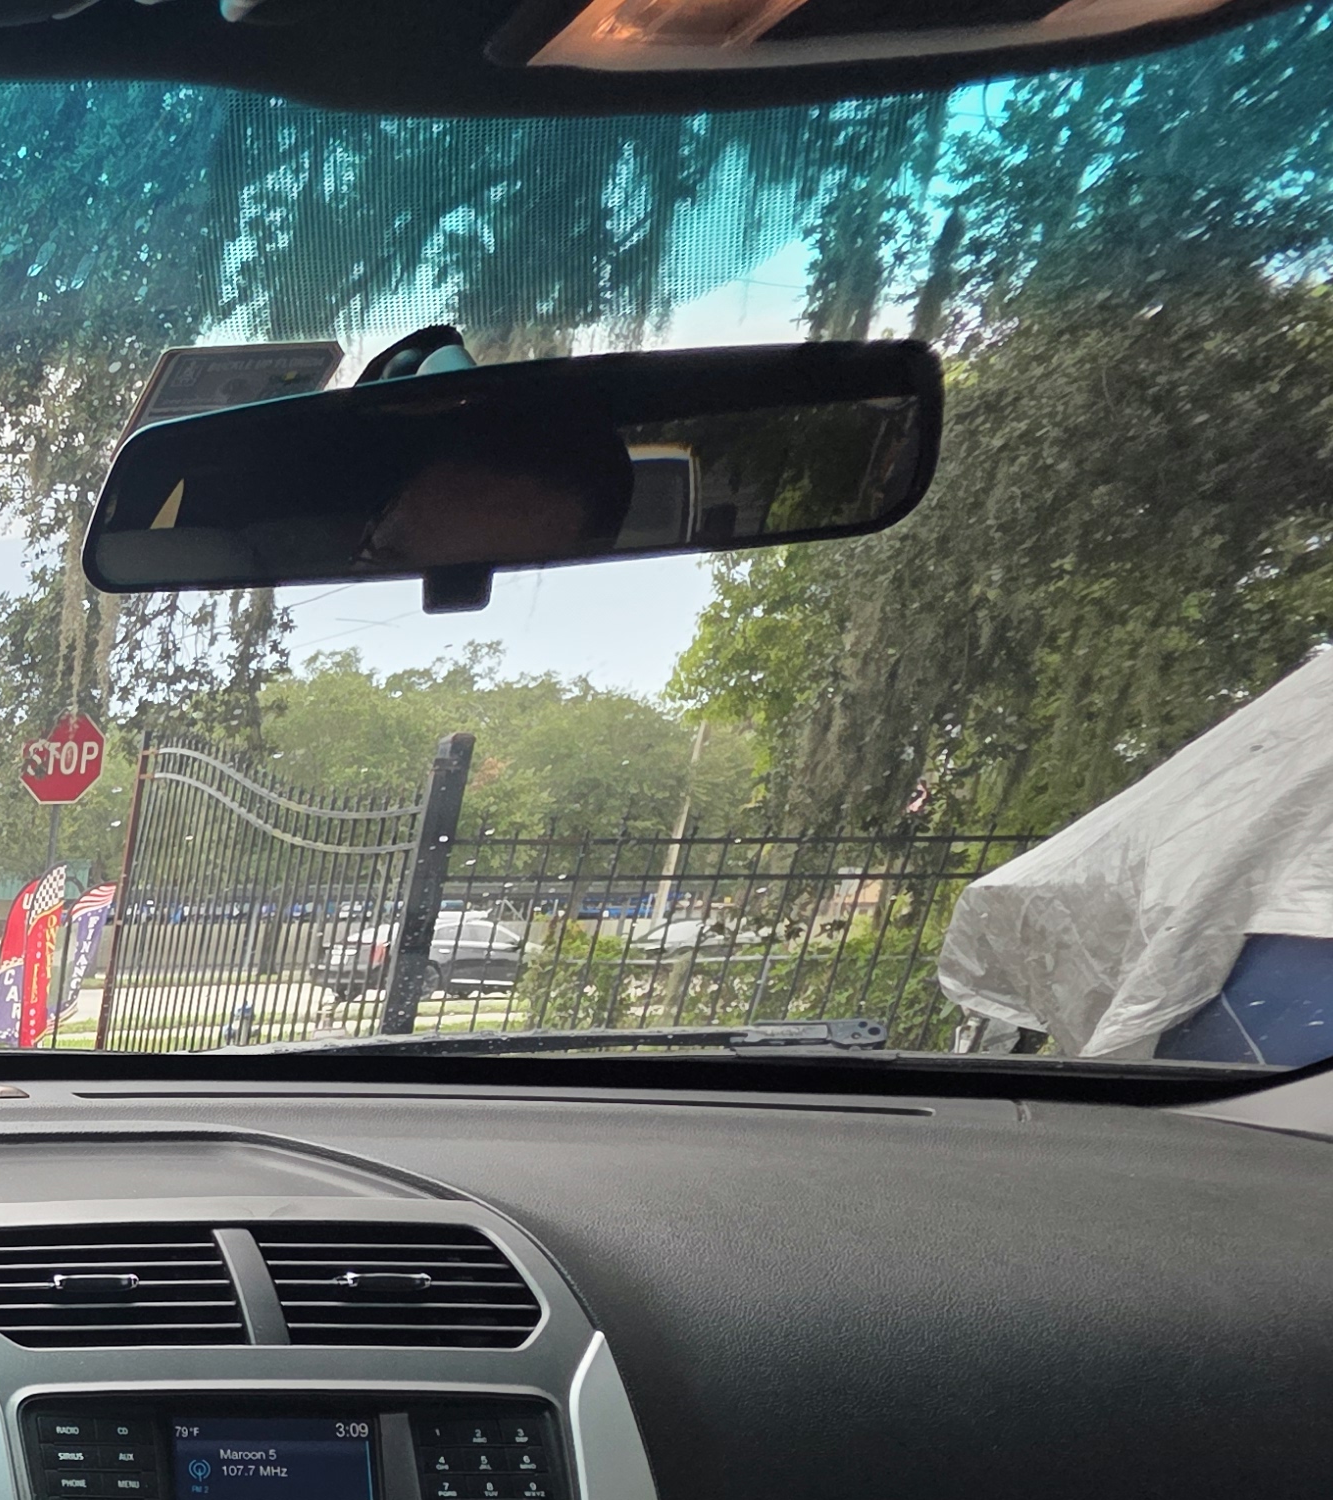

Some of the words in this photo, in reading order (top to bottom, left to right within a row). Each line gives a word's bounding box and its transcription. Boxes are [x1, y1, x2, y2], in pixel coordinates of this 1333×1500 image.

[27, 740, 99, 775] STOP
[56, 1426, 80, 1435] RADIO
[117, 1426, 129, 1435] CD
[335, 1422, 369, 1438] 3:09
[435, 1428, 441, 1437] 1
[474, 1428, 482, 1437] 2
[516, 1428, 525, 1437] 3
[58, 1452, 84, 1461] SIRIUS
[118, 1453, 135, 1461] AUX
[219, 1449, 266, 1460] Maroon
[268, 1449, 277, 1460] 5
[522, 1454, 531, 1463] 6
[438, 1456, 446, 1464] 4
[480, 1455, 488, 1464] 5
[222, 1466, 256, 1477] 107.7
[259, 1466, 289, 1477] MHz
[61, 1479, 87, 1488] PHONE
[117, 1480, 140, 1489] MENU
[442, 1482, 450, 1491] 7
[486, 1482, 494, 1491] 8
[529, 1482, 537, 1491] 9
[203, 1485, 210, 1494] 2
